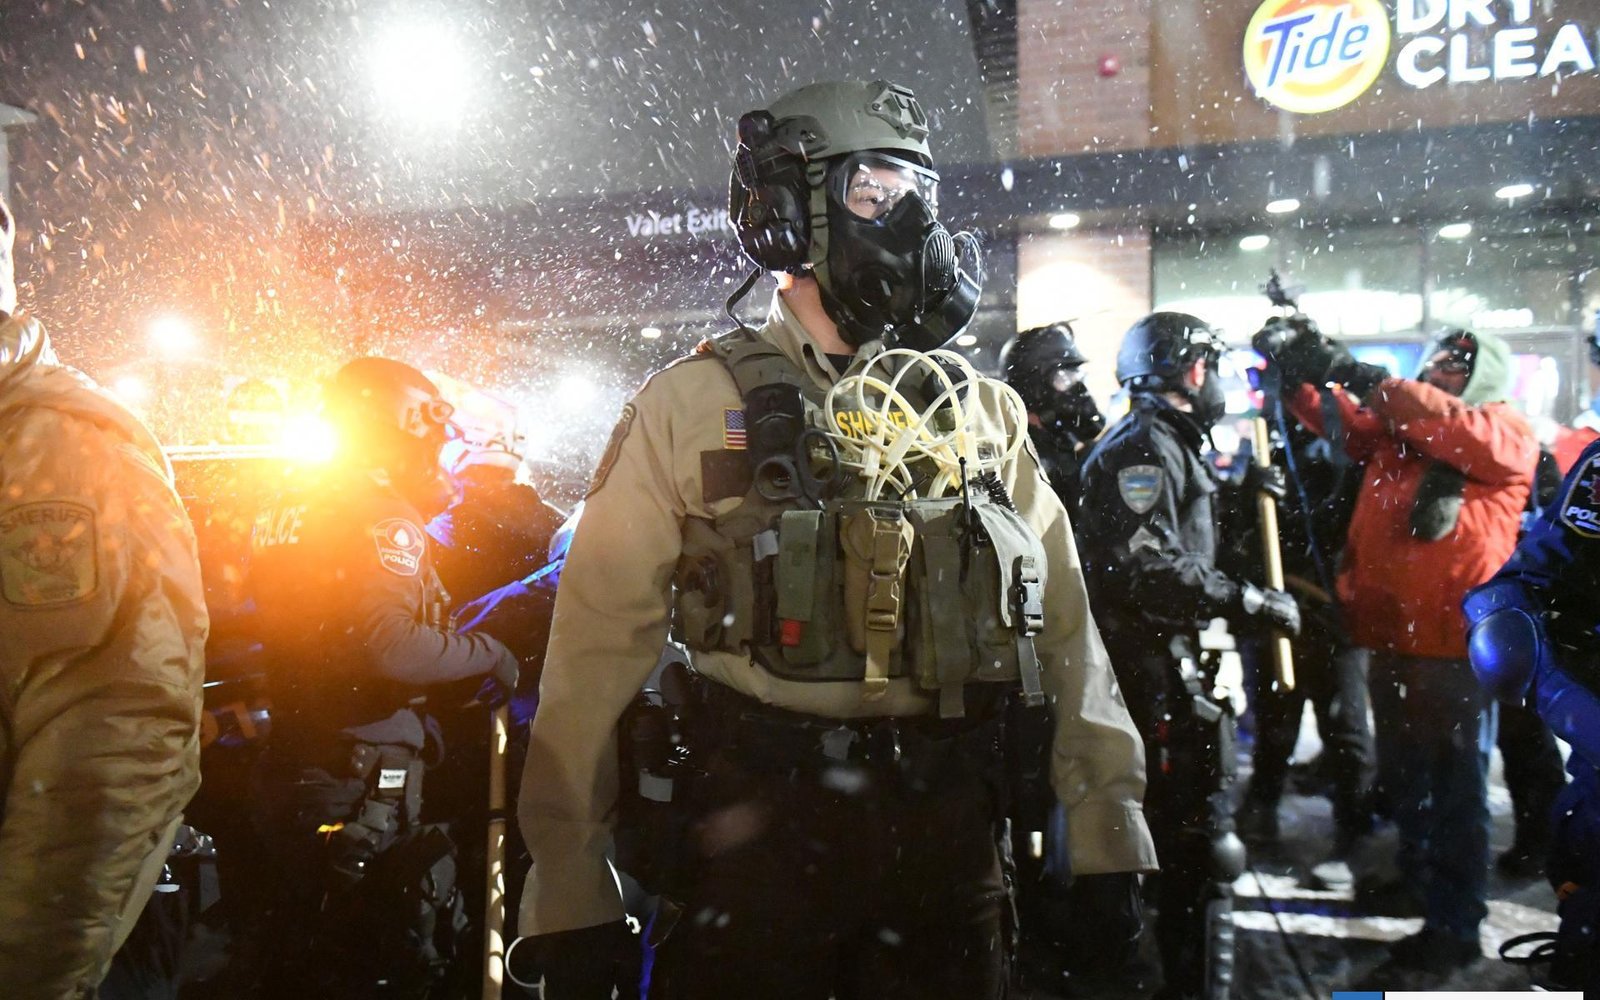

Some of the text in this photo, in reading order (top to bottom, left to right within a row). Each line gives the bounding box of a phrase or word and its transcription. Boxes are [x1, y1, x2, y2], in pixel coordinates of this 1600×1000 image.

[1263, 12, 1370, 87] Tide
[1397, 24, 1600, 88] CLEA
[625, 208, 728, 237] Valet Exit
